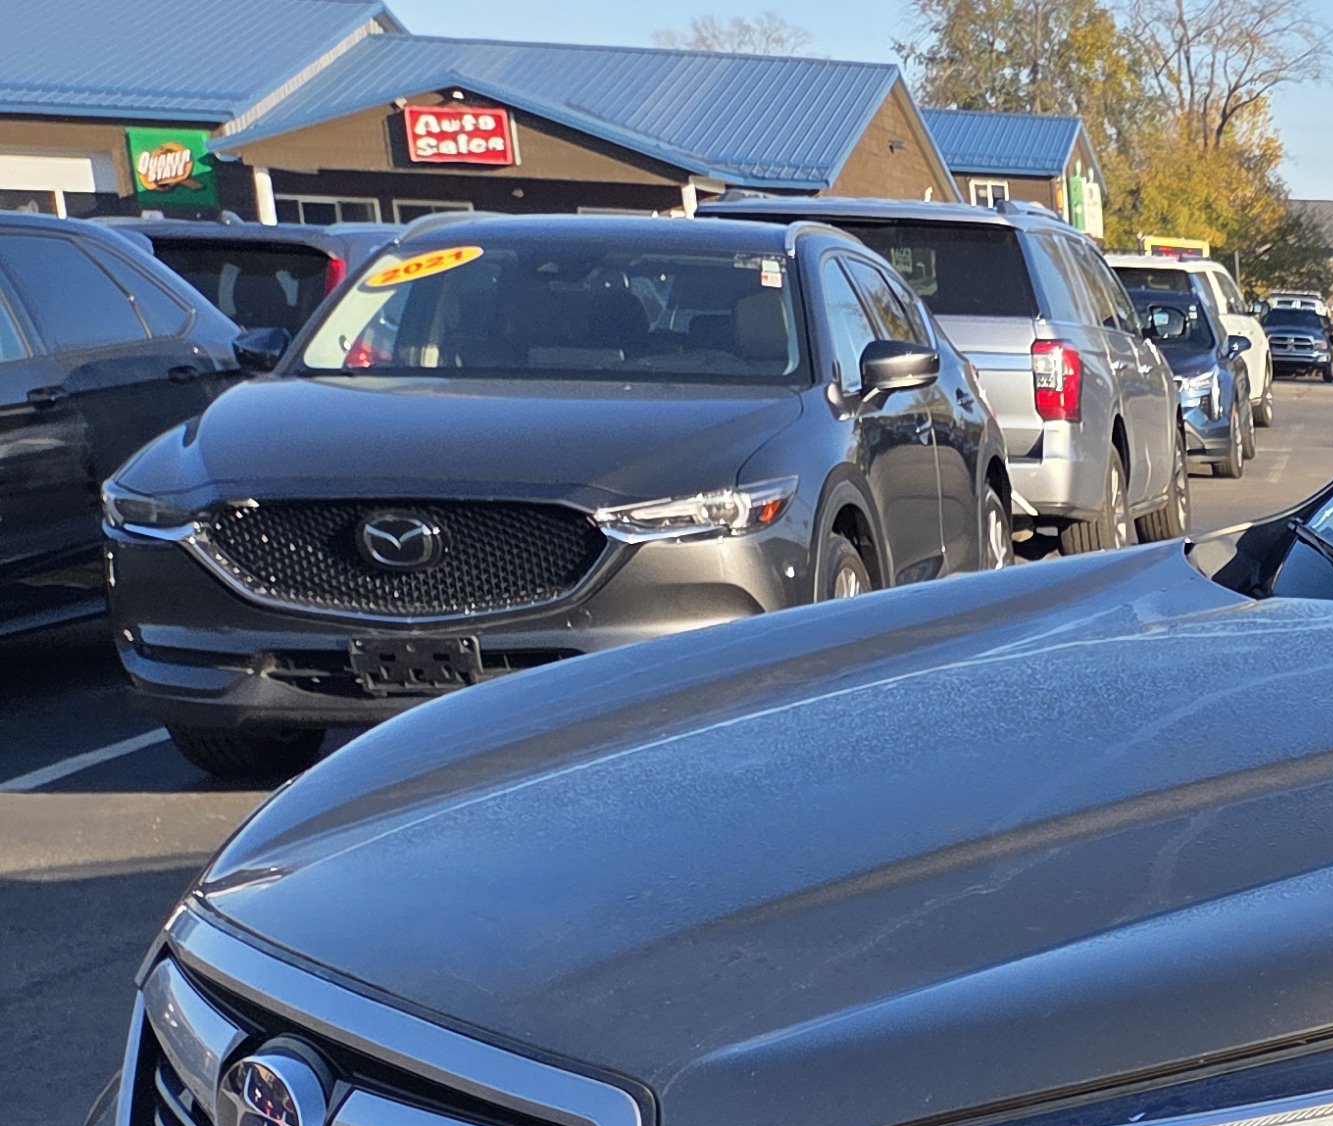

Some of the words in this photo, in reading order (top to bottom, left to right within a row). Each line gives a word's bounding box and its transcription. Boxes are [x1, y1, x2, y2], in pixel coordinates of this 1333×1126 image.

[414, 114, 496, 136] Auto
[416, 133, 505, 156] Sales
[380, 251, 463, 285] 2021
